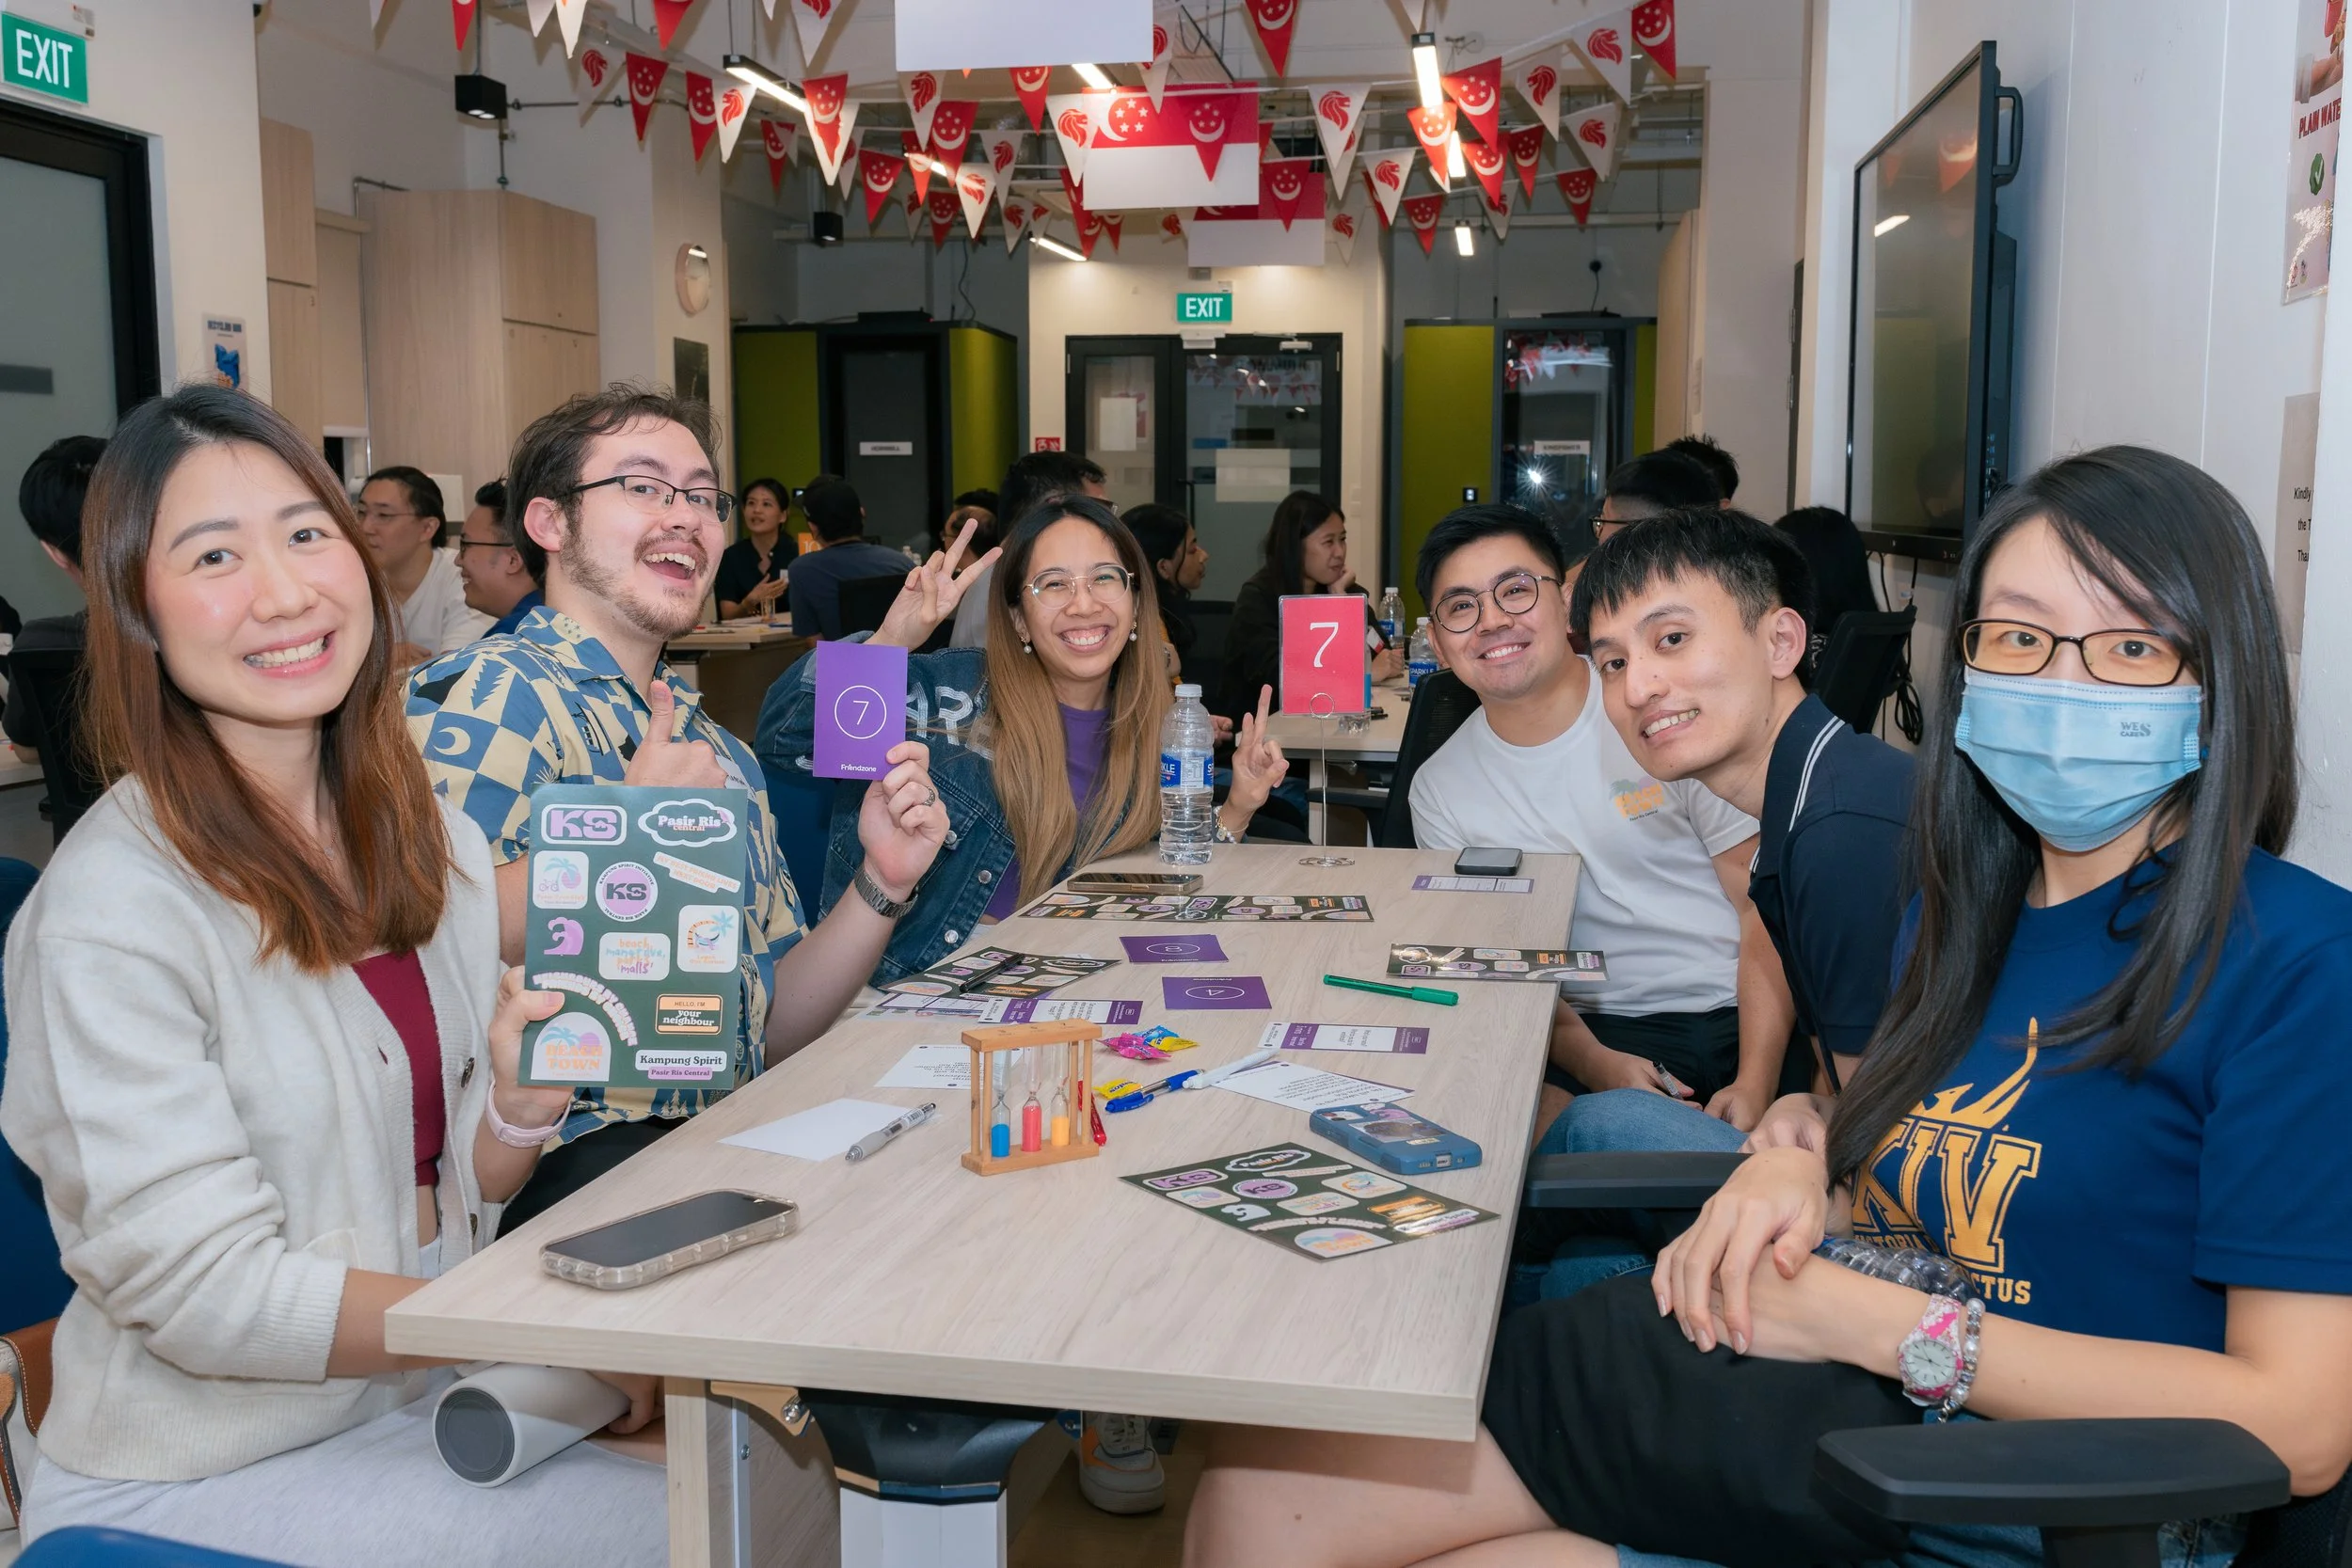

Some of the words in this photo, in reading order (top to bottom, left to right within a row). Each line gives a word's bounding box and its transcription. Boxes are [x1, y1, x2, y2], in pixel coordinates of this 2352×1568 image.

[16, 28, 73, 88] EXIT
[2298, 107, 2320, 139] PLAIN
[2321, 97, 2342, 128] WATE
[1185, 297, 1223, 318] EXIT
[2294, 487, 2312, 502] Kindly
[2297, 518, 2307, 531] the
[2297, 549, 2309, 562] Tha
[1310, 622, 1339, 668] 7
[852, 700, 869, 725] 7
[550, 810, 617, 839] KS
[659, 815, 695, 828] Pasir
[698, 816, 722, 828] Ris
[606, 882, 647, 900] KS
[662, 1016, 715, 1026] neighbour
[676, 1009, 702, 1019] your
[546, 1044, 603, 1056] BEACH
[548, 1058, 600, 1070] TOWN
[640, 1054, 691, 1067] Kampung
[692, 1055, 723, 1067] Spirit
[1972, 1273, 2031, 1305] CTUS
